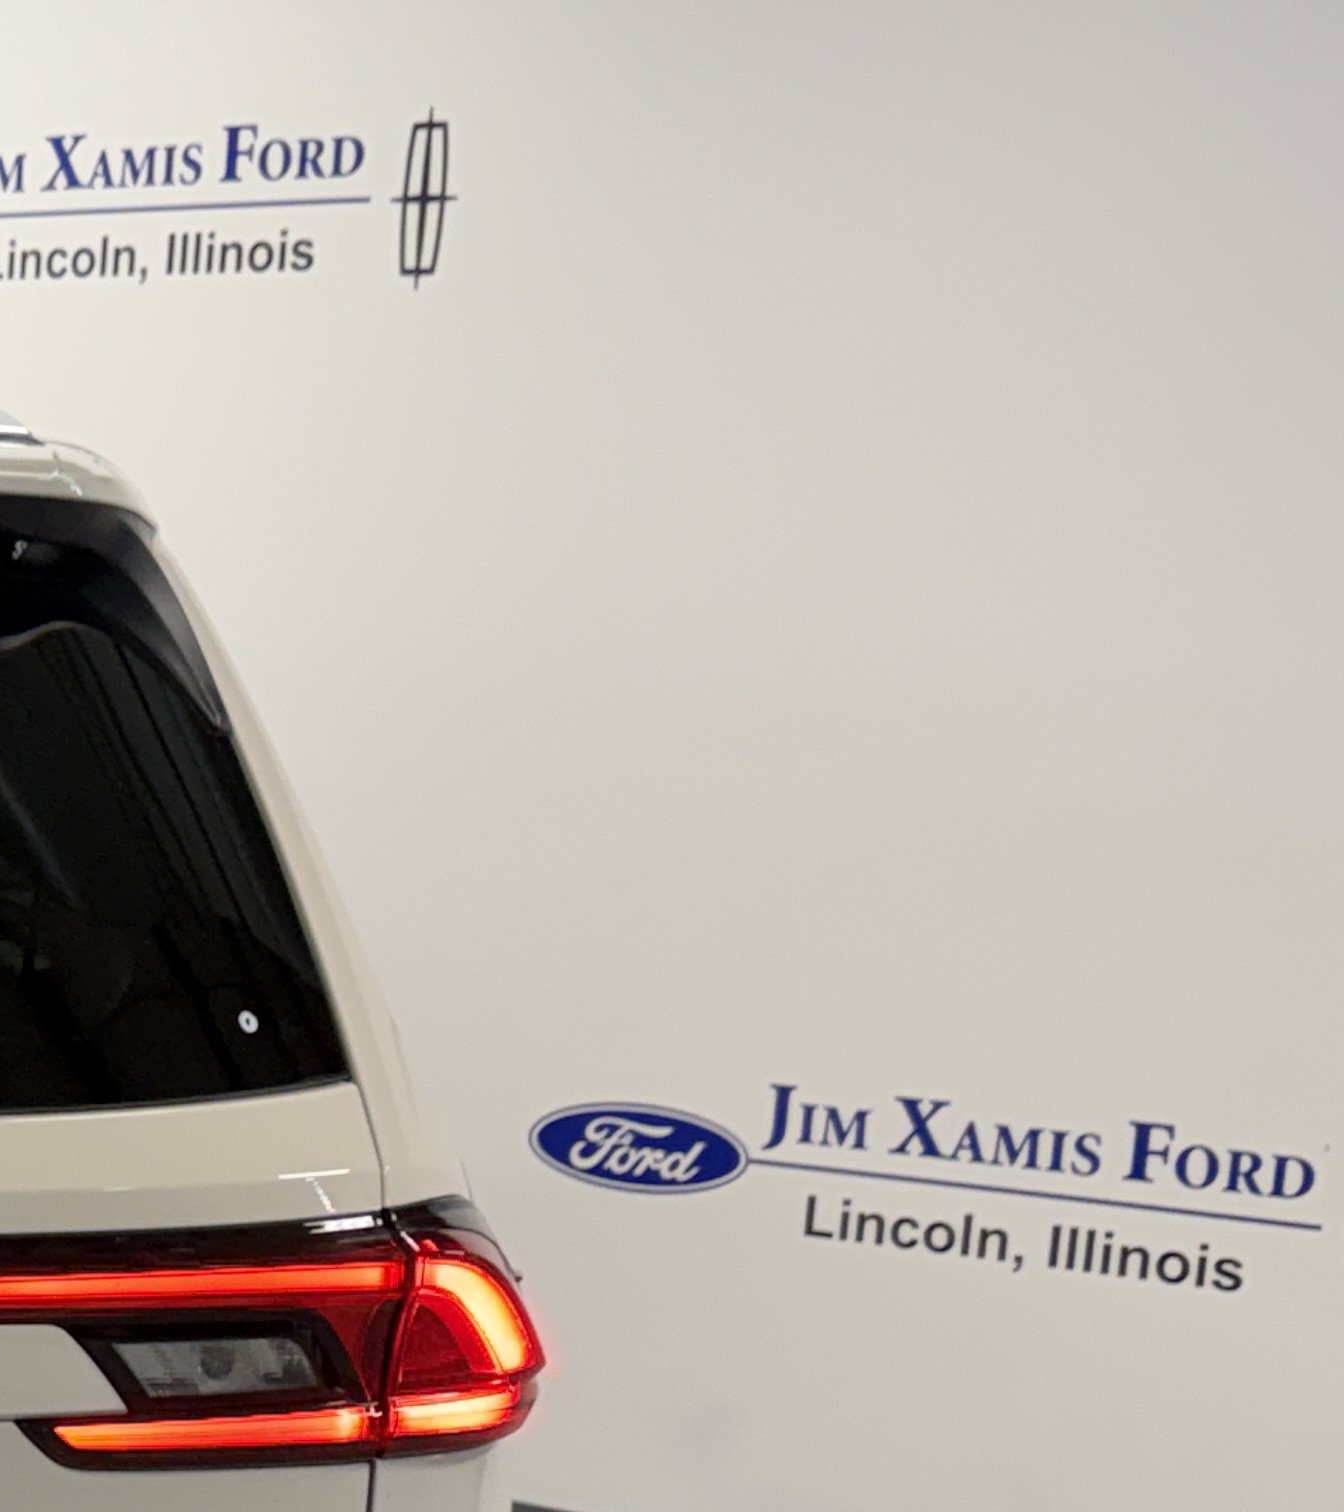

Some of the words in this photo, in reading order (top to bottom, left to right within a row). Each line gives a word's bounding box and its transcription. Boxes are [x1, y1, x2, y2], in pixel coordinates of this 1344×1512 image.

[45, 134, 203, 191] XAMIS
[219, 125, 365, 183] FORD
[165, 229, 315, 275] Illinois
[569, 1115, 703, 1184] Ford
[762, 1084, 871, 1152] JIM
[889, 1097, 1103, 1177] XAMIS
[1121, 1120, 1316, 1200] FORD
[804, 1194, 1027, 1272] Lincoln,
[1047, 1224, 1244, 1292] Illinois
